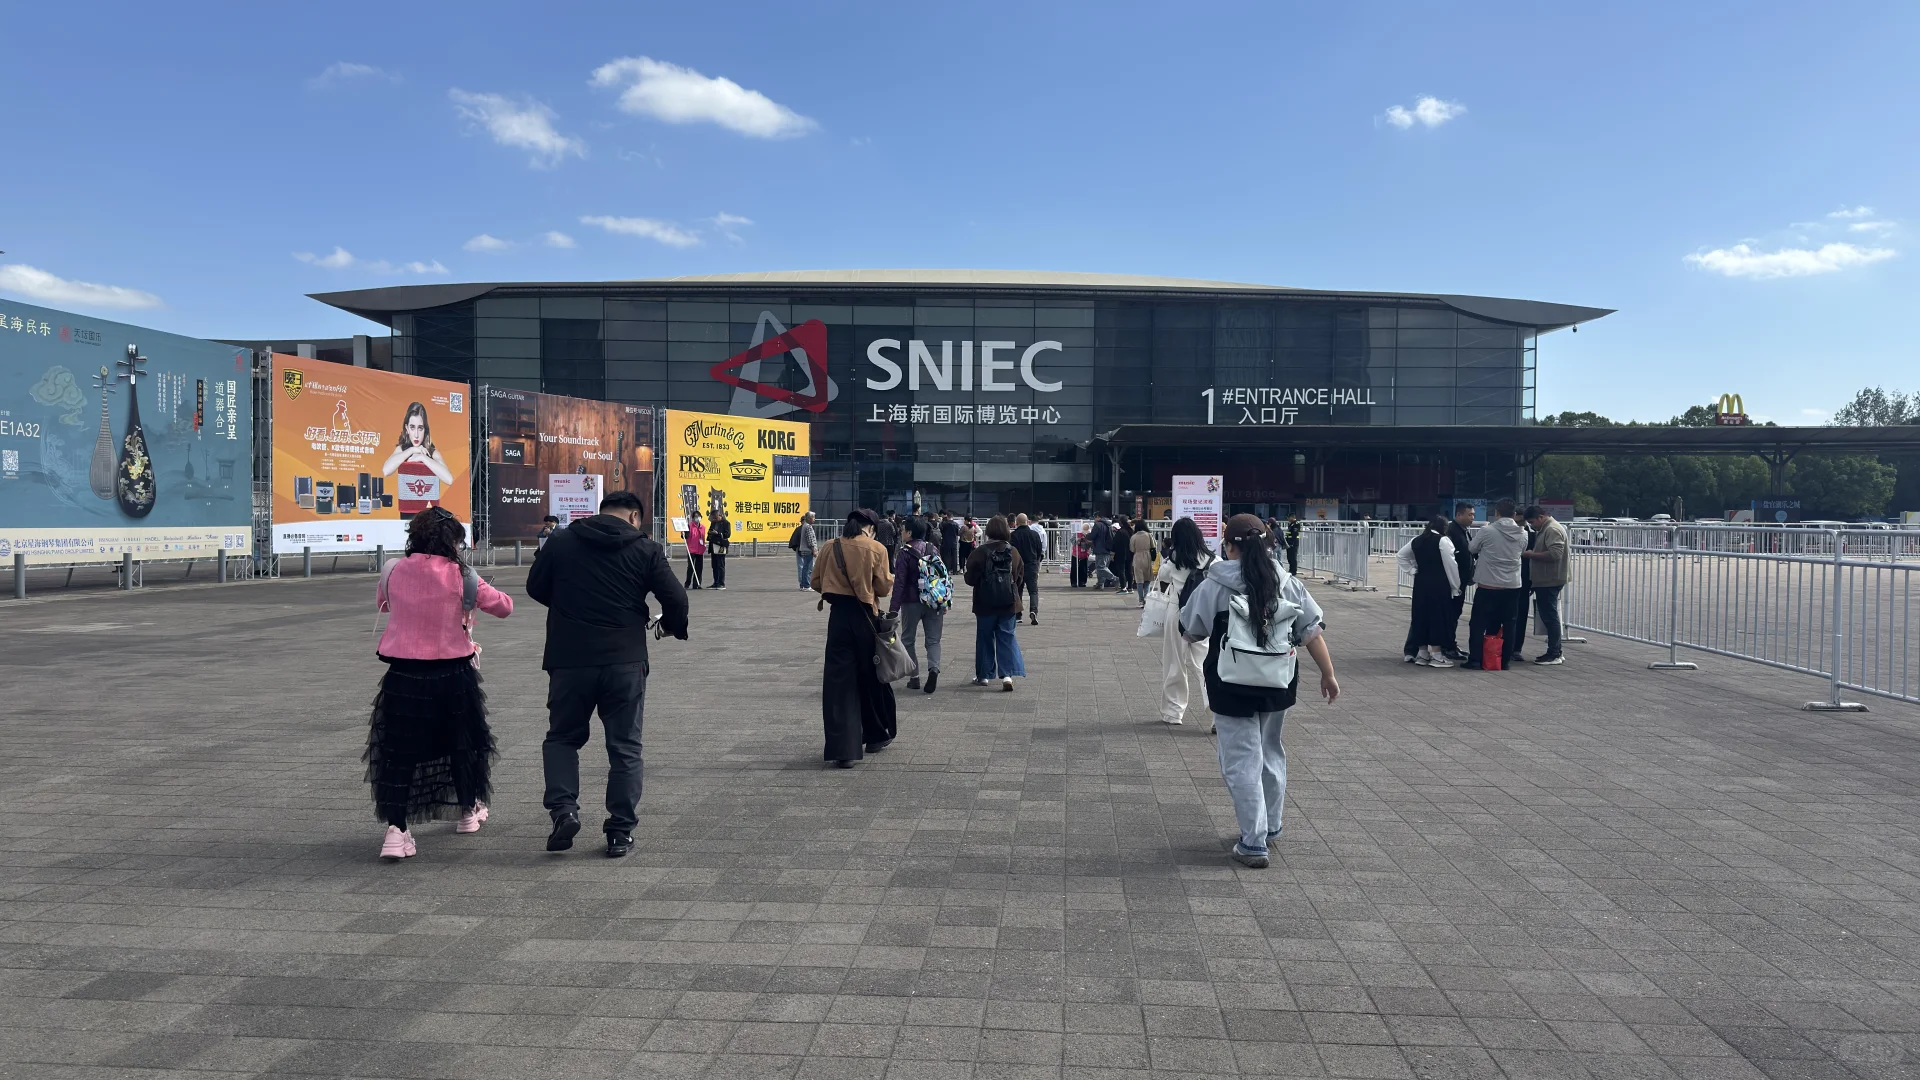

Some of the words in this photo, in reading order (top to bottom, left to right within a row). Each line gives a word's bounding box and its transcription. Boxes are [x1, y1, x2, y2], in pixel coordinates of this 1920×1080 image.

[866, 338, 1063, 392] SNIEC
[490, 389, 507, 399] SAGA
[215, 381, 225, 435] 道器合一
[1201, 389, 1214, 424] 1
[1222, 388, 1328, 405] #ENTRANCE
[1333, 388, 1376, 405] HALL
[866, 404, 1061, 425] 上海新国际博览中心
[1238, 407, 1299, 425] 入口厅
[0, 420, 40, 438] E1A32
[539, 432, 557, 443] Your
[558, 434, 599, 446] Soundtrack
[758, 429, 795, 451] KORG
[505, 449, 521, 457] SAGA
[583, 450, 596, 460] Our
[597, 451, 613, 461] Soul
[679, 455, 705, 472] PRS
[735, 467, 761, 475] VOX
[502, 487, 514, 495] Your
[735, 502, 770, 514] 雅登中国
[774, 502, 800, 514] W5B12
[14, 538, 94, 548] 北京星海钢琴集团有限公司
